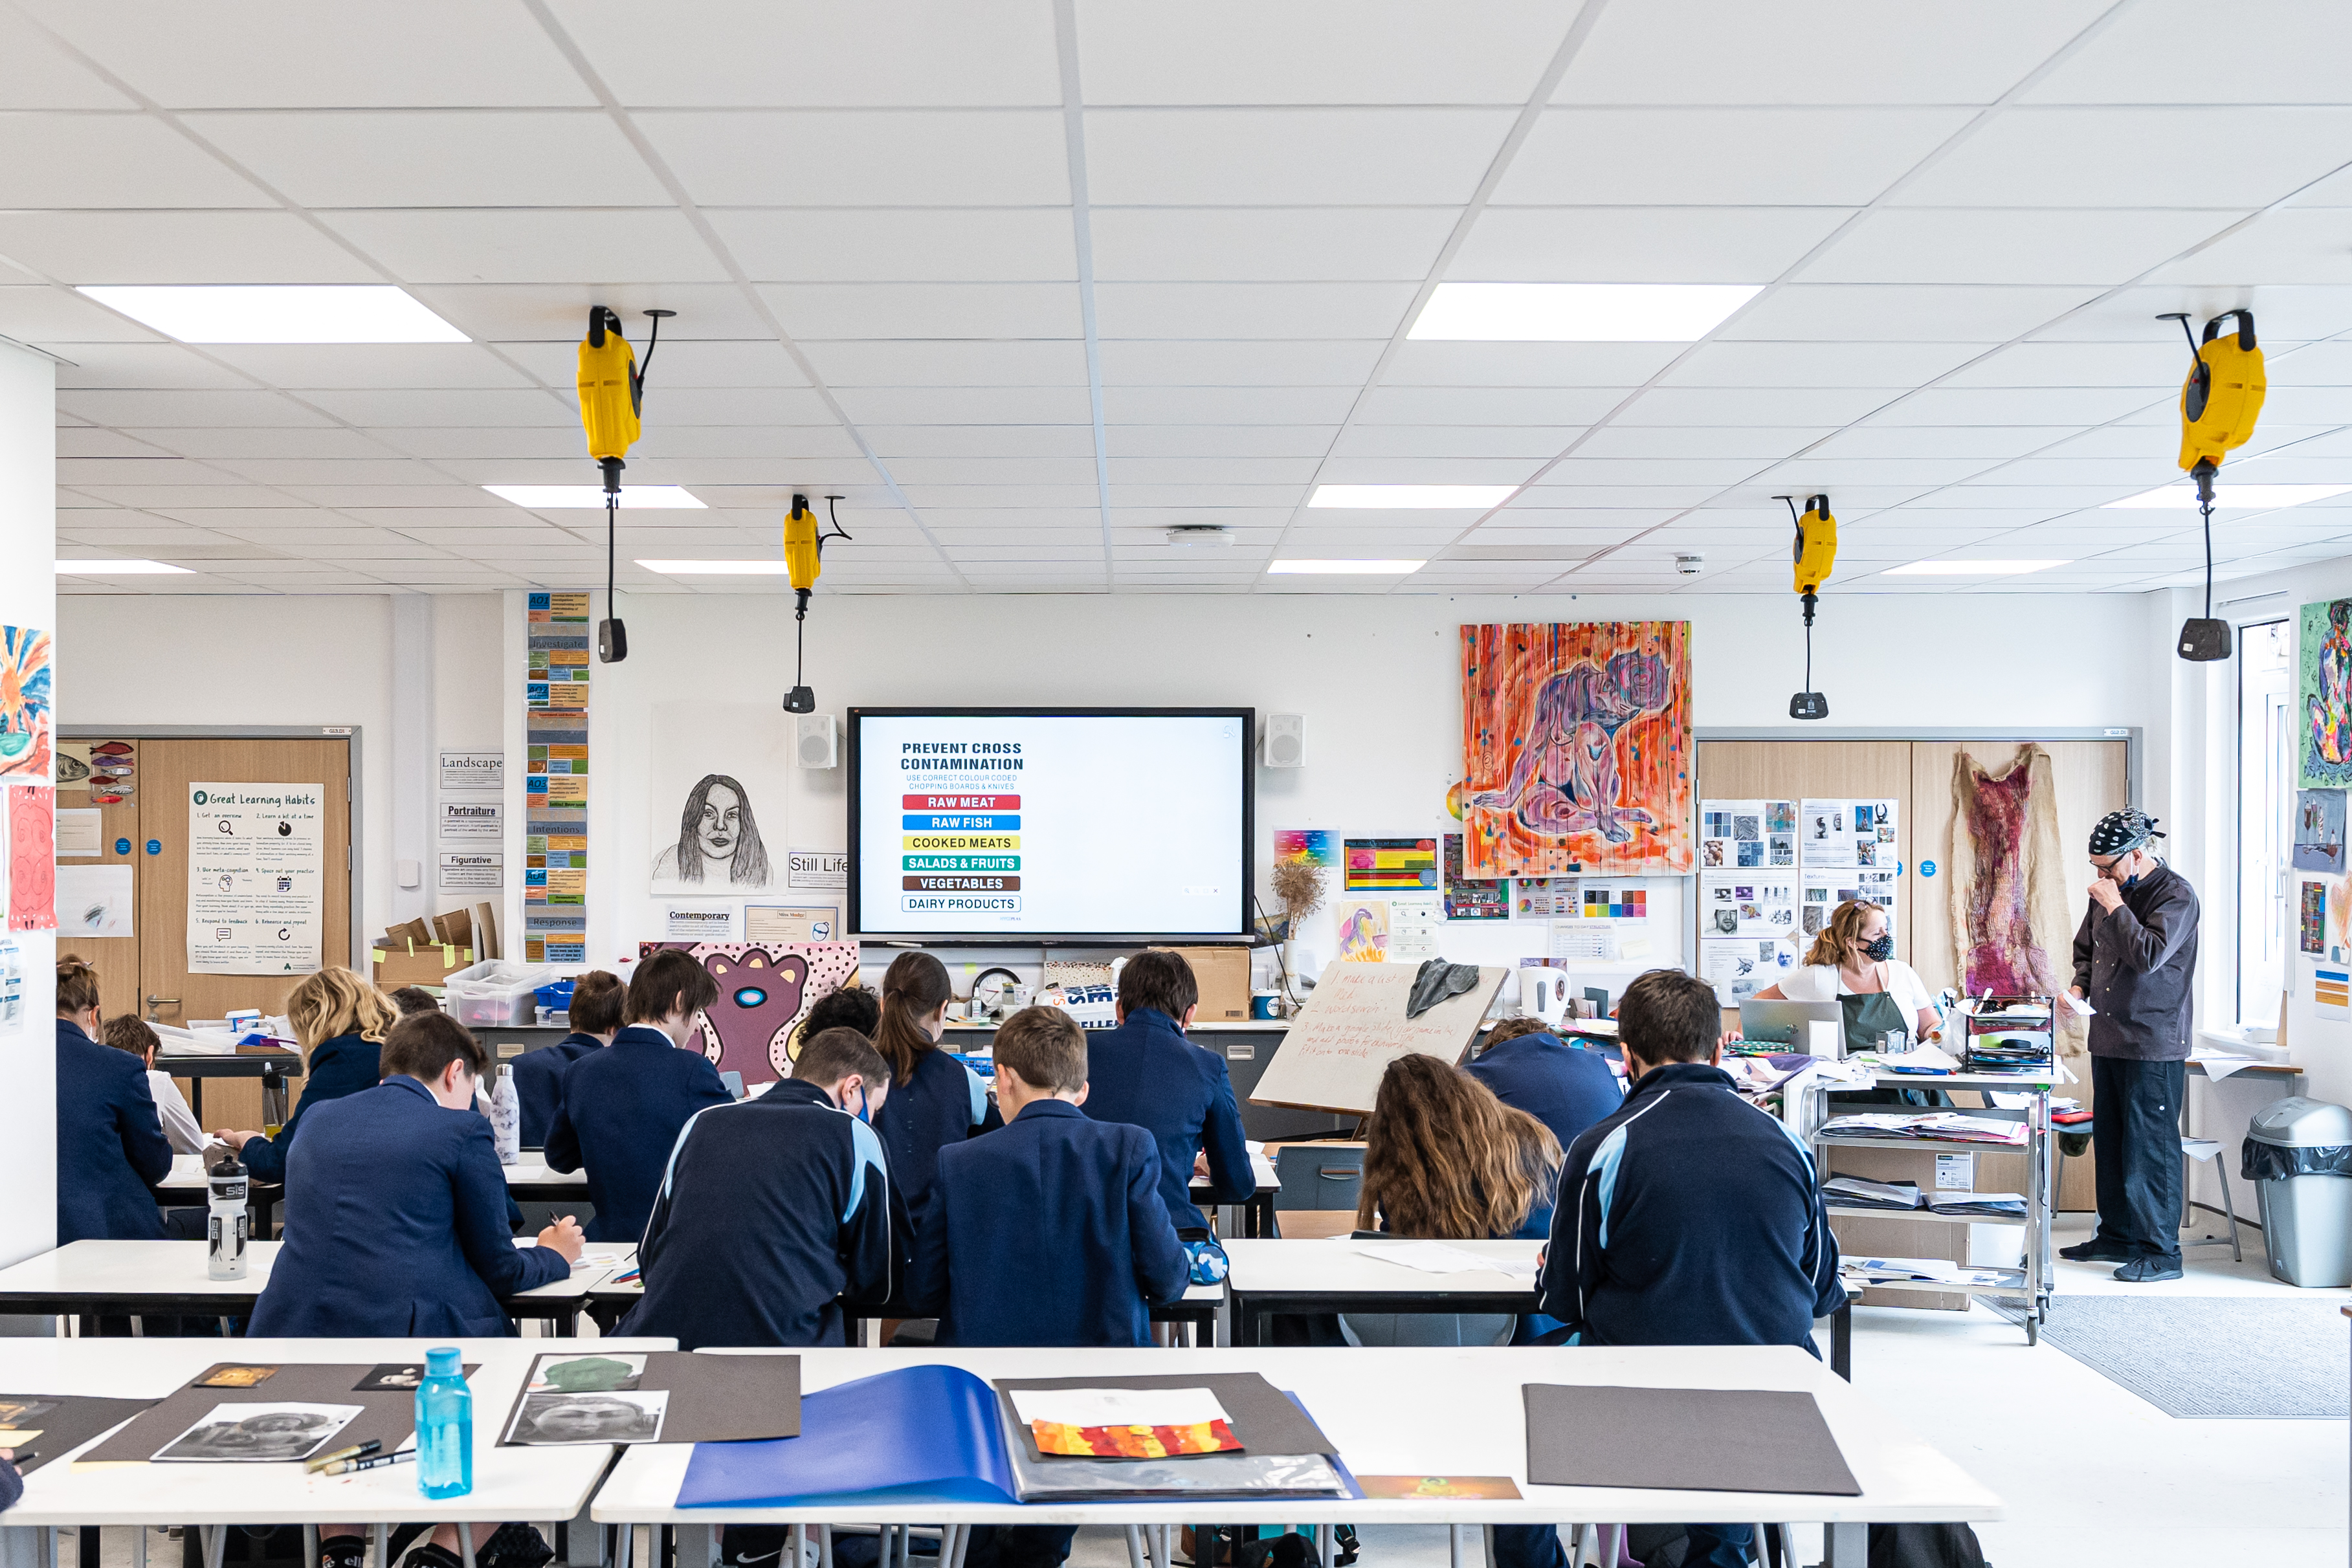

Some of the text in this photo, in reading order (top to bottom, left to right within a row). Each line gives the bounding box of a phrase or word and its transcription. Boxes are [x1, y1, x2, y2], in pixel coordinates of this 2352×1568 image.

[530, 596, 549, 605] AO1
[533, 640, 582, 649] Investigate
[902, 743, 1021, 754] PREVENT CROSS
[442, 756, 502, 770] Landscape
[901, 758, 1023, 770] CONTAMINATION
[527, 779, 547, 788] AO3
[210, 793, 315, 808] Great Learning Habits
[928, 797, 995, 808] RAW MEAT
[448, 806, 496, 815] Portraiture
[932, 817, 992, 828] RAW FISH
[913, 838, 1011, 848] COOKED MEATS
[451, 856, 492, 865] Figurative
[791, 857, 847, 872] Still Life
[909, 858, 1015, 868] SALADS & FRUITS
[526, 872, 546, 880] AO4
[920, 878, 1003, 889] VEGETABLES
[909, 899, 1014, 909] DAIRY PRODUCTS
[669, 911, 730, 920] Contemporary
[533, 918, 577, 927] Response
[1377, 973, 1397, 984] list
